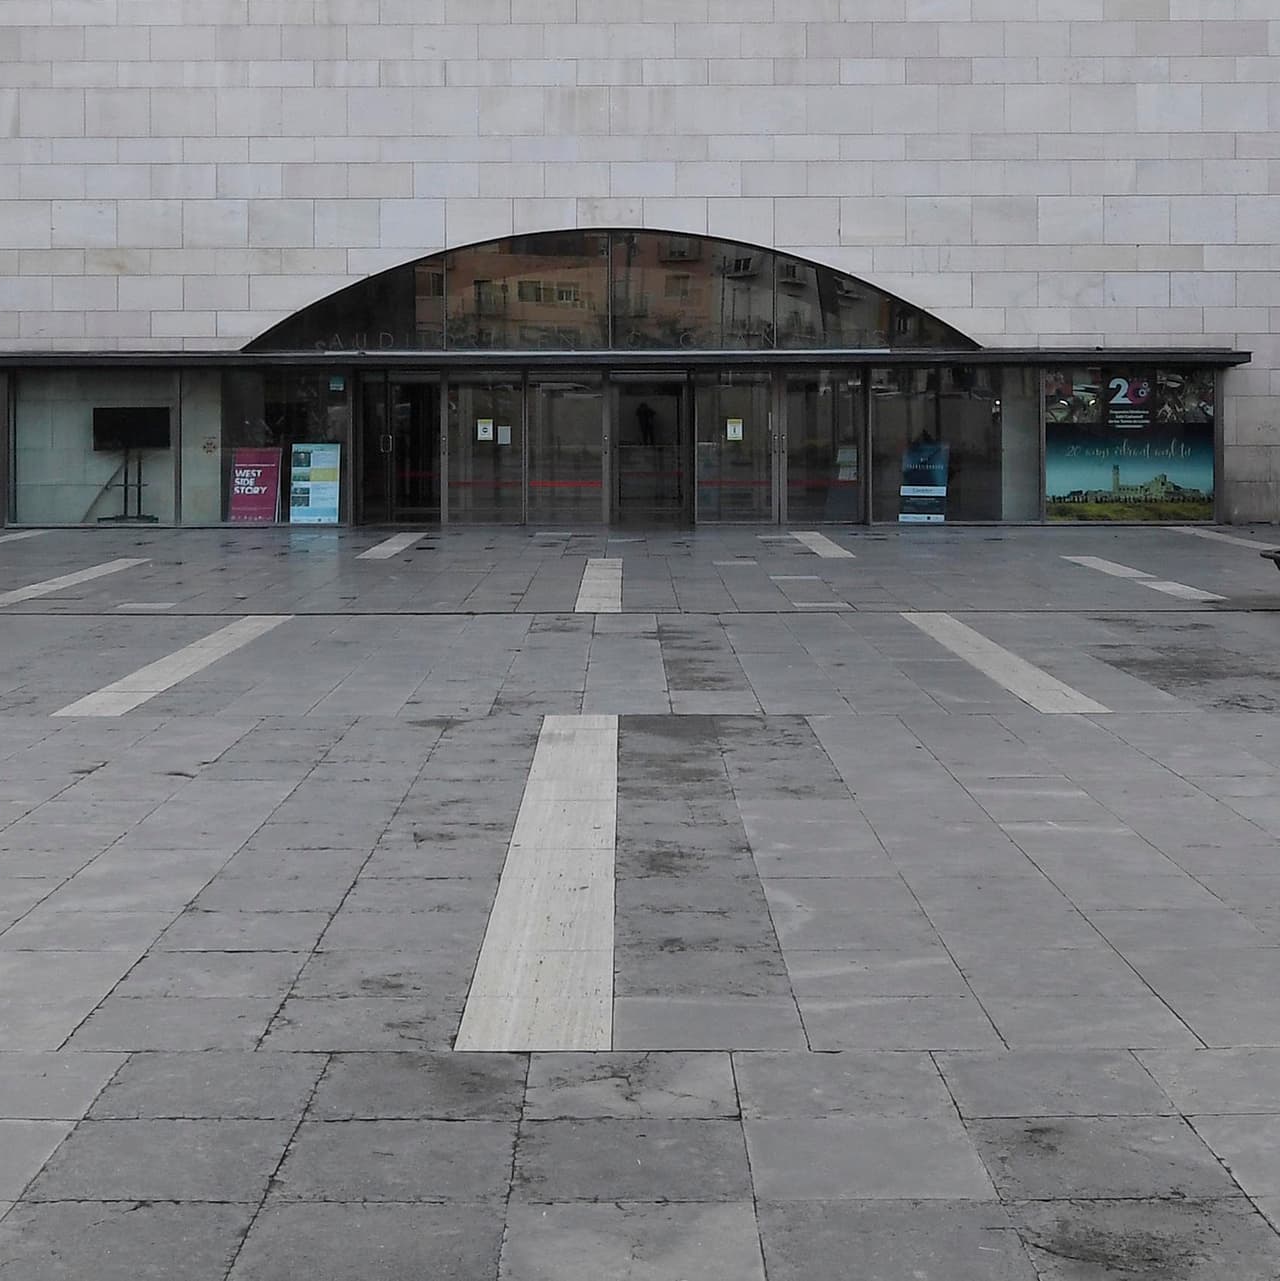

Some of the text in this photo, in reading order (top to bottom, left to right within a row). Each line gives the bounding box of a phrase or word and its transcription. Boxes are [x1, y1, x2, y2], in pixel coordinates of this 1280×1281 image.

[235, 469, 262, 477] WEST
[234, 478, 256, 486] SIDE
[233, 486, 268, 495] STORY
